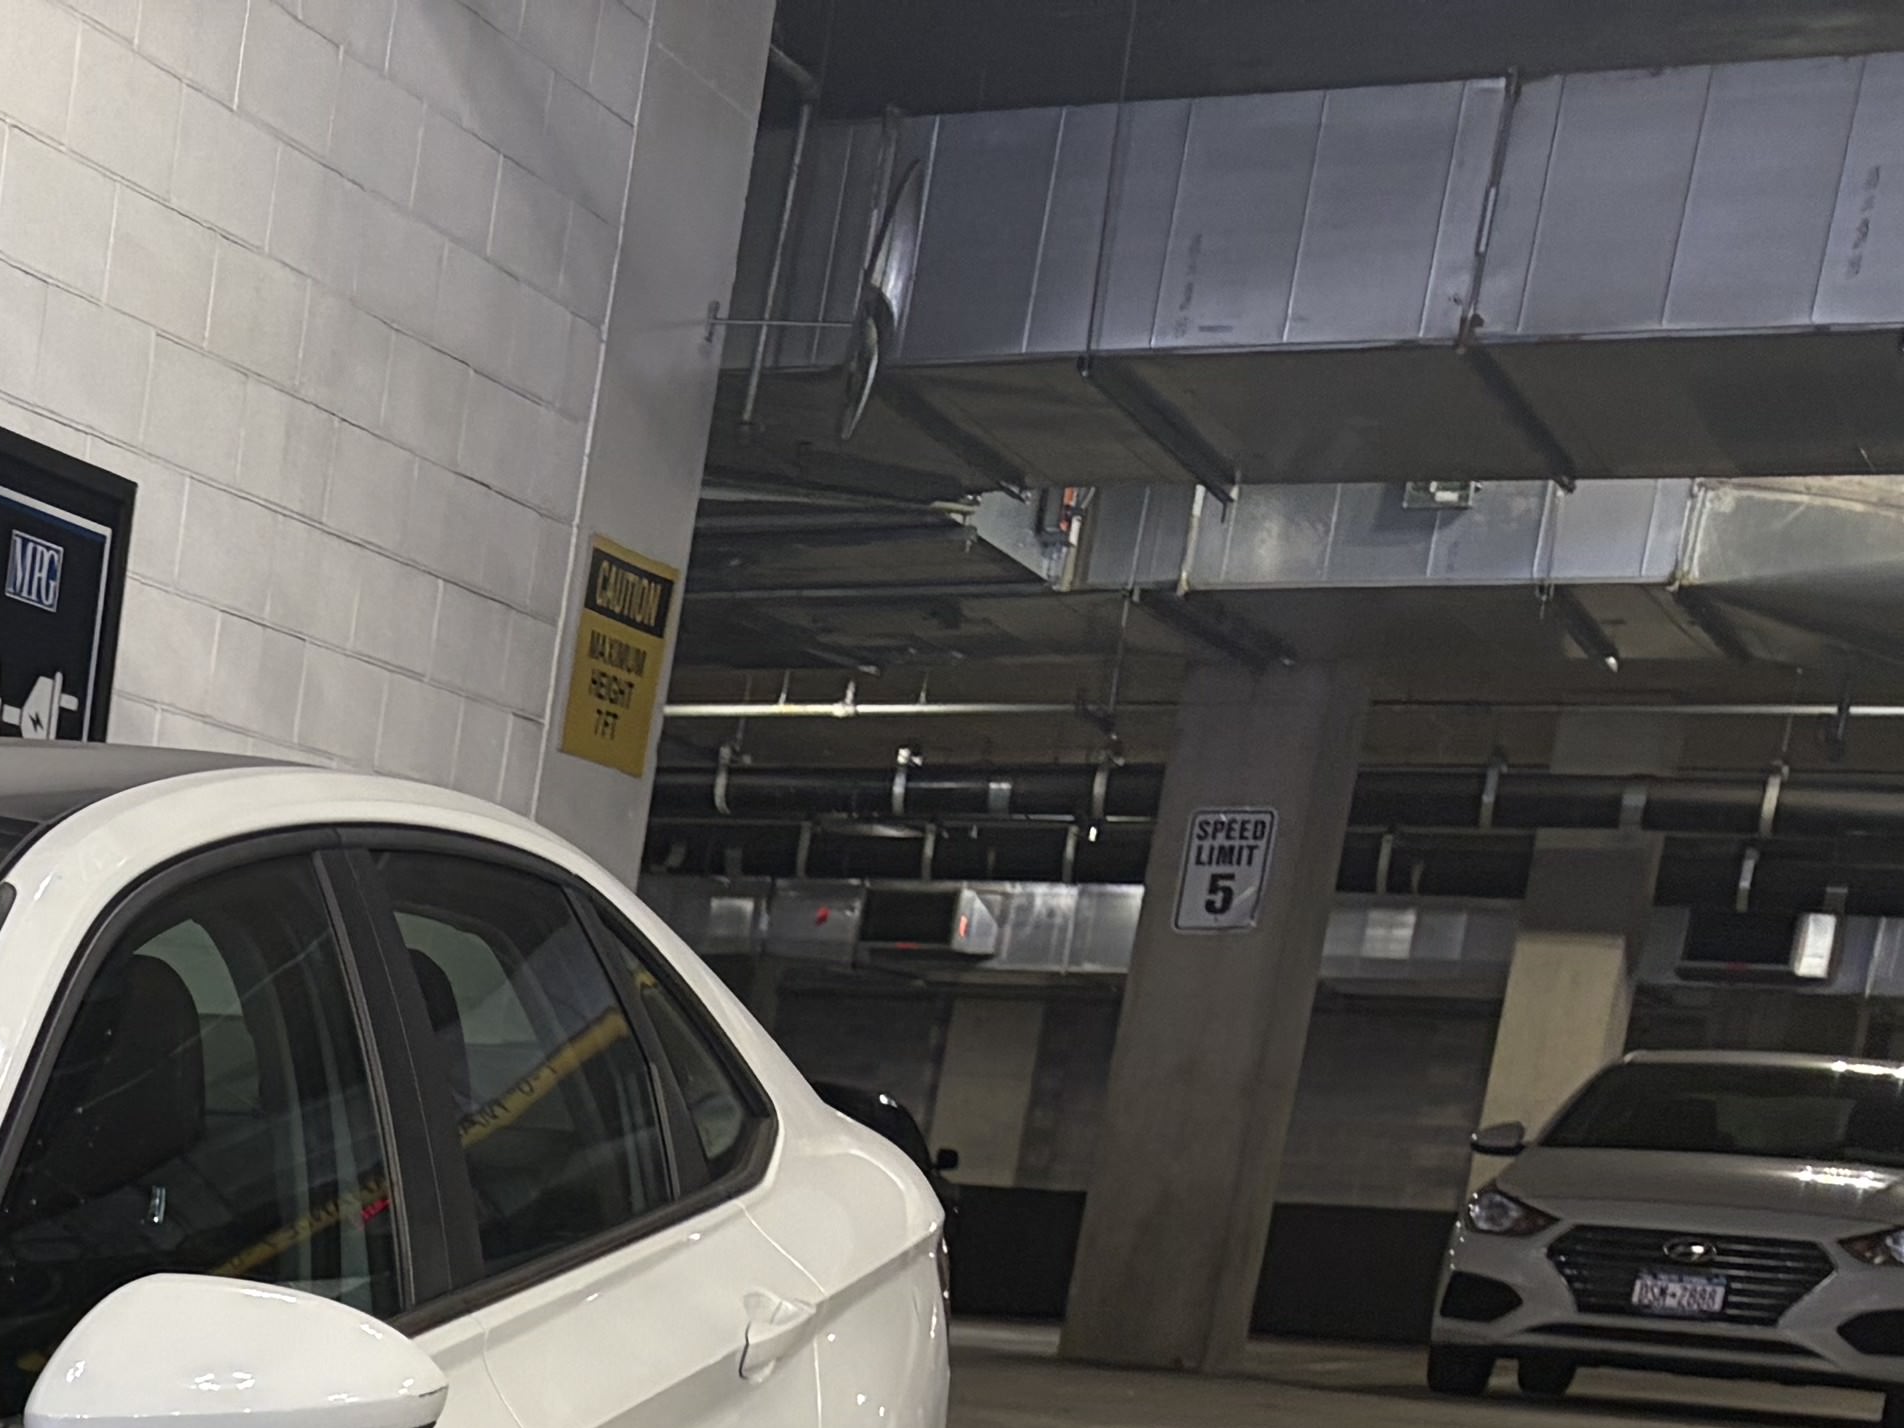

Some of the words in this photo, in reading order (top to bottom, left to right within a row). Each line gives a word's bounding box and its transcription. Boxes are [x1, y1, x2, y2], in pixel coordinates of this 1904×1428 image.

[596, 560, 662, 627] CAUTION
[589, 630, 646, 677] MAXIMUM
[1196, 818, 1267, 841] SPEED
[1195, 844, 1259, 867] LIMIT
[1205, 873, 1235, 915] 5
